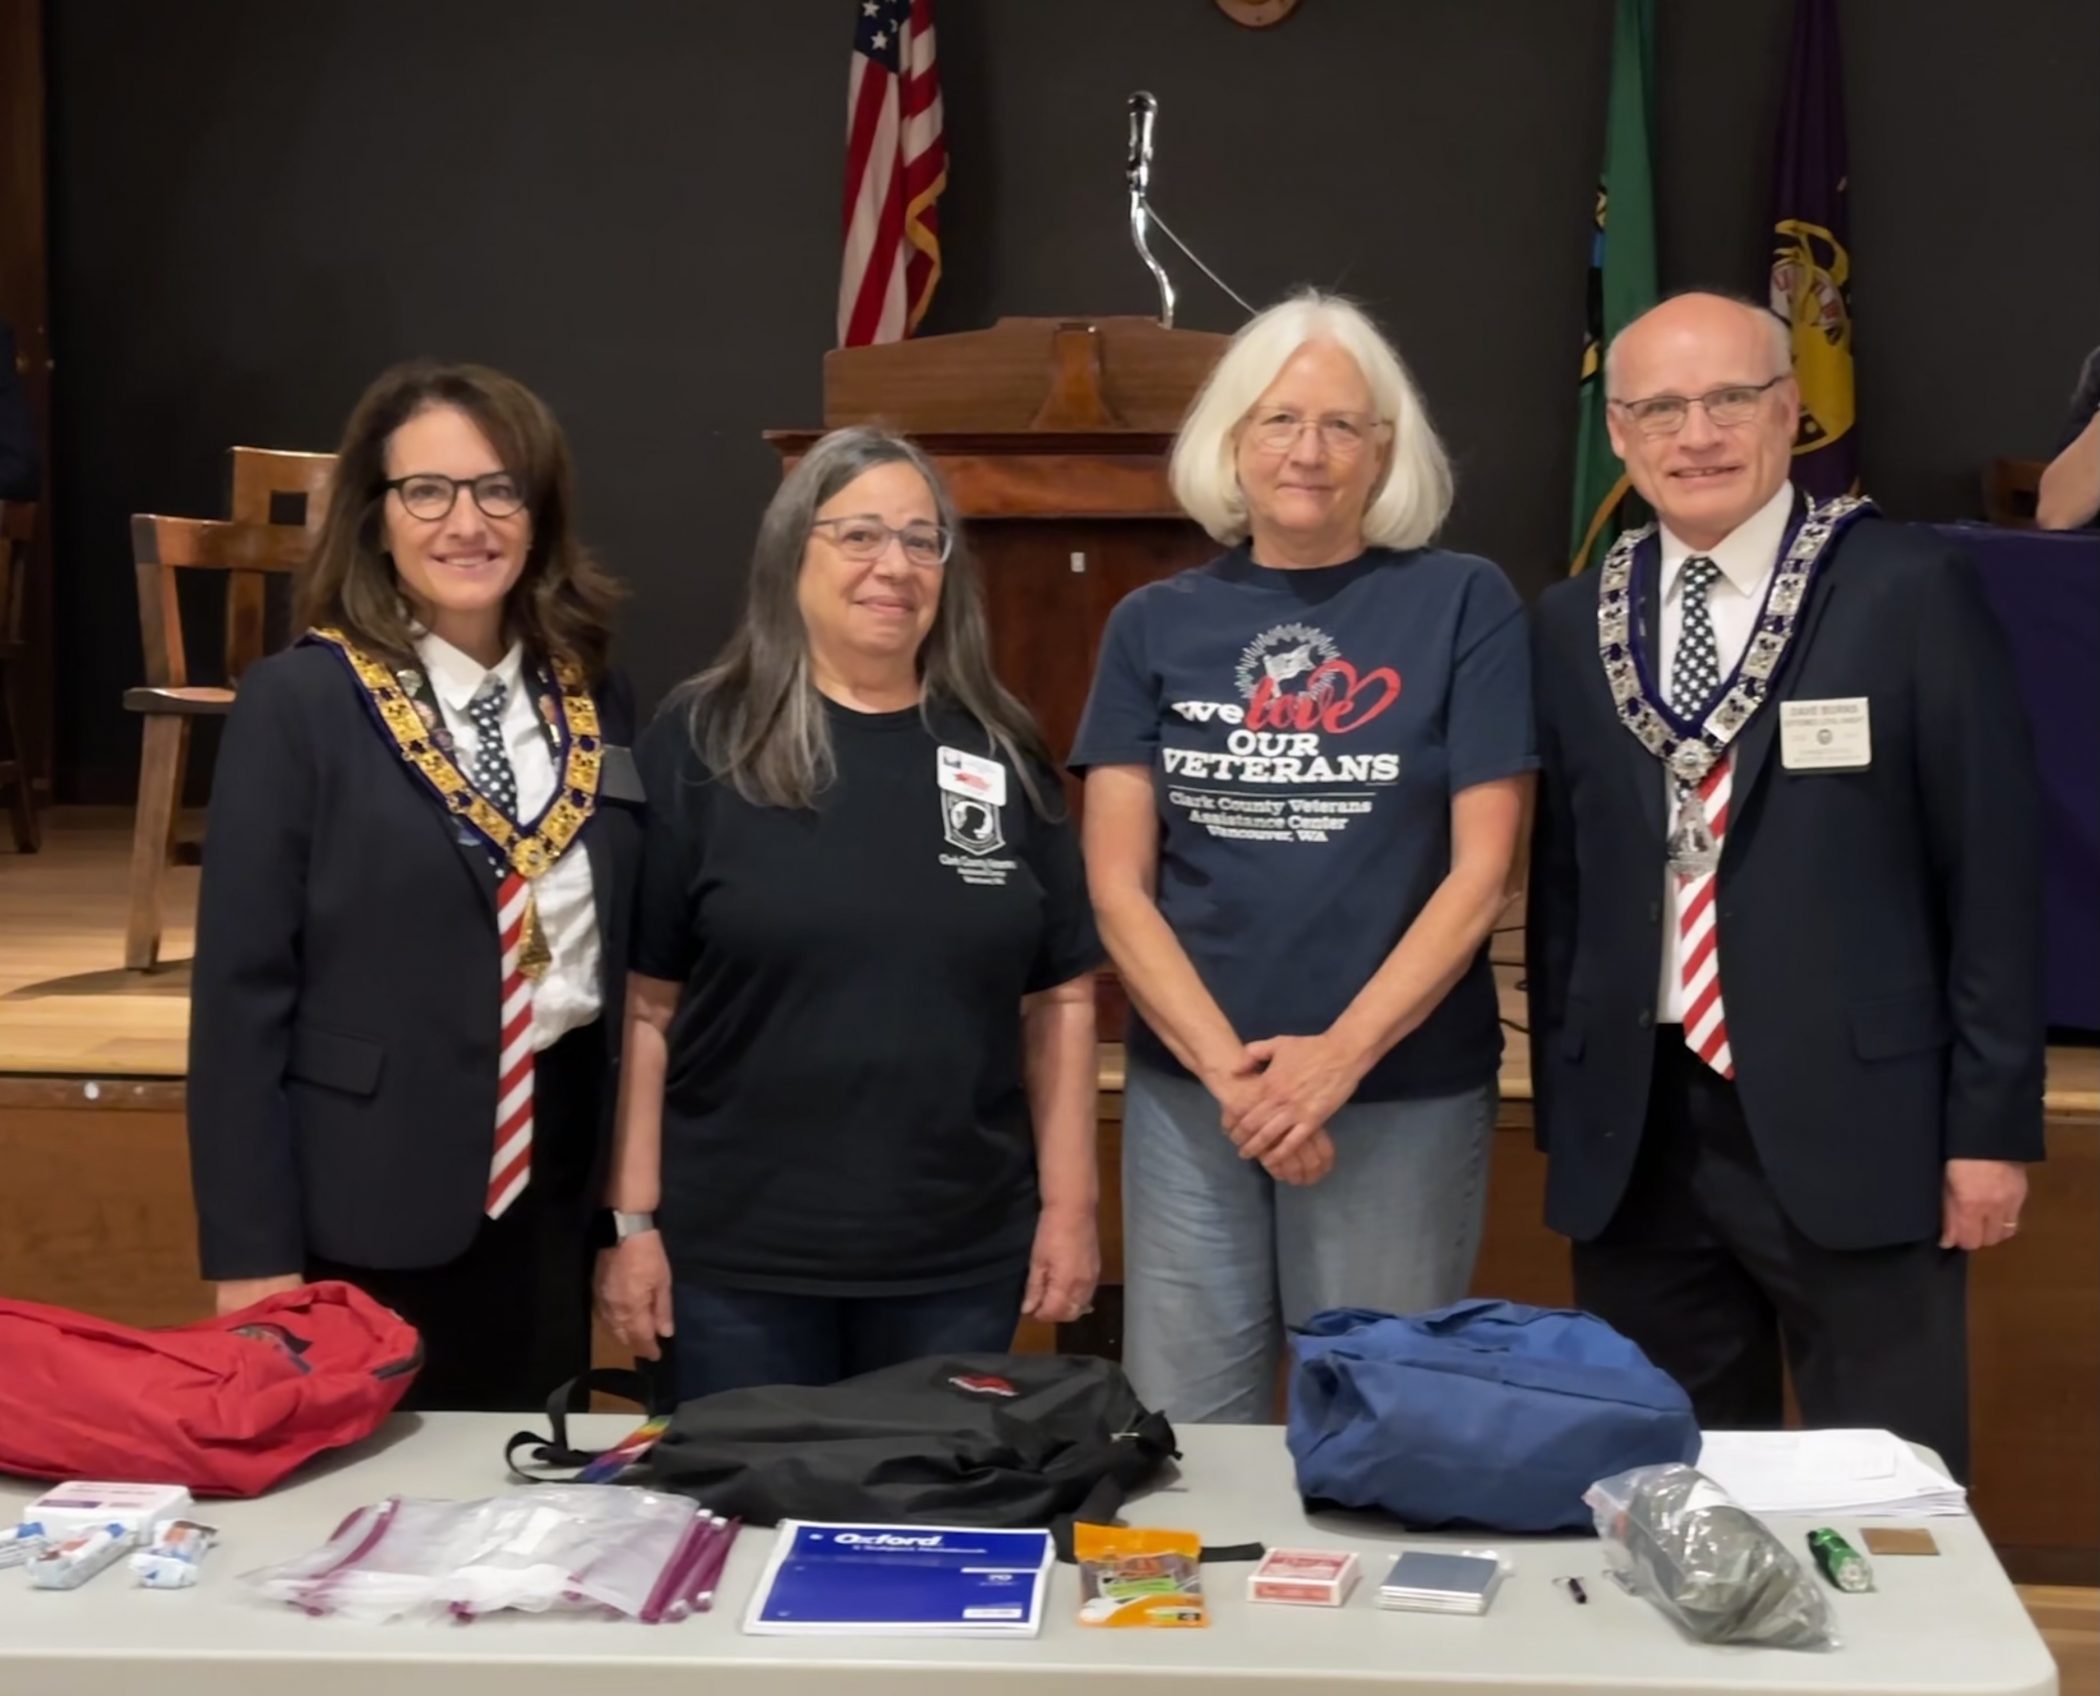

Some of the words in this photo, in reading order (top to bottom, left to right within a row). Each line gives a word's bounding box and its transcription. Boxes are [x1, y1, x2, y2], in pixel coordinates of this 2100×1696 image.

[1244, 659, 1401, 734] love
[1227, 729, 1320, 756] OUR
[1162, 748, 1400, 783] VETERANS
[1169, 791, 1215, 810] Clark
[1217, 797, 1285, 816] County
[1288, 799, 1373, 813] Veterans
[1188, 810, 1285, 829] Assistance
[1296, 829, 1329, 842] WA
[834, 1533, 943, 1546] Oxford
